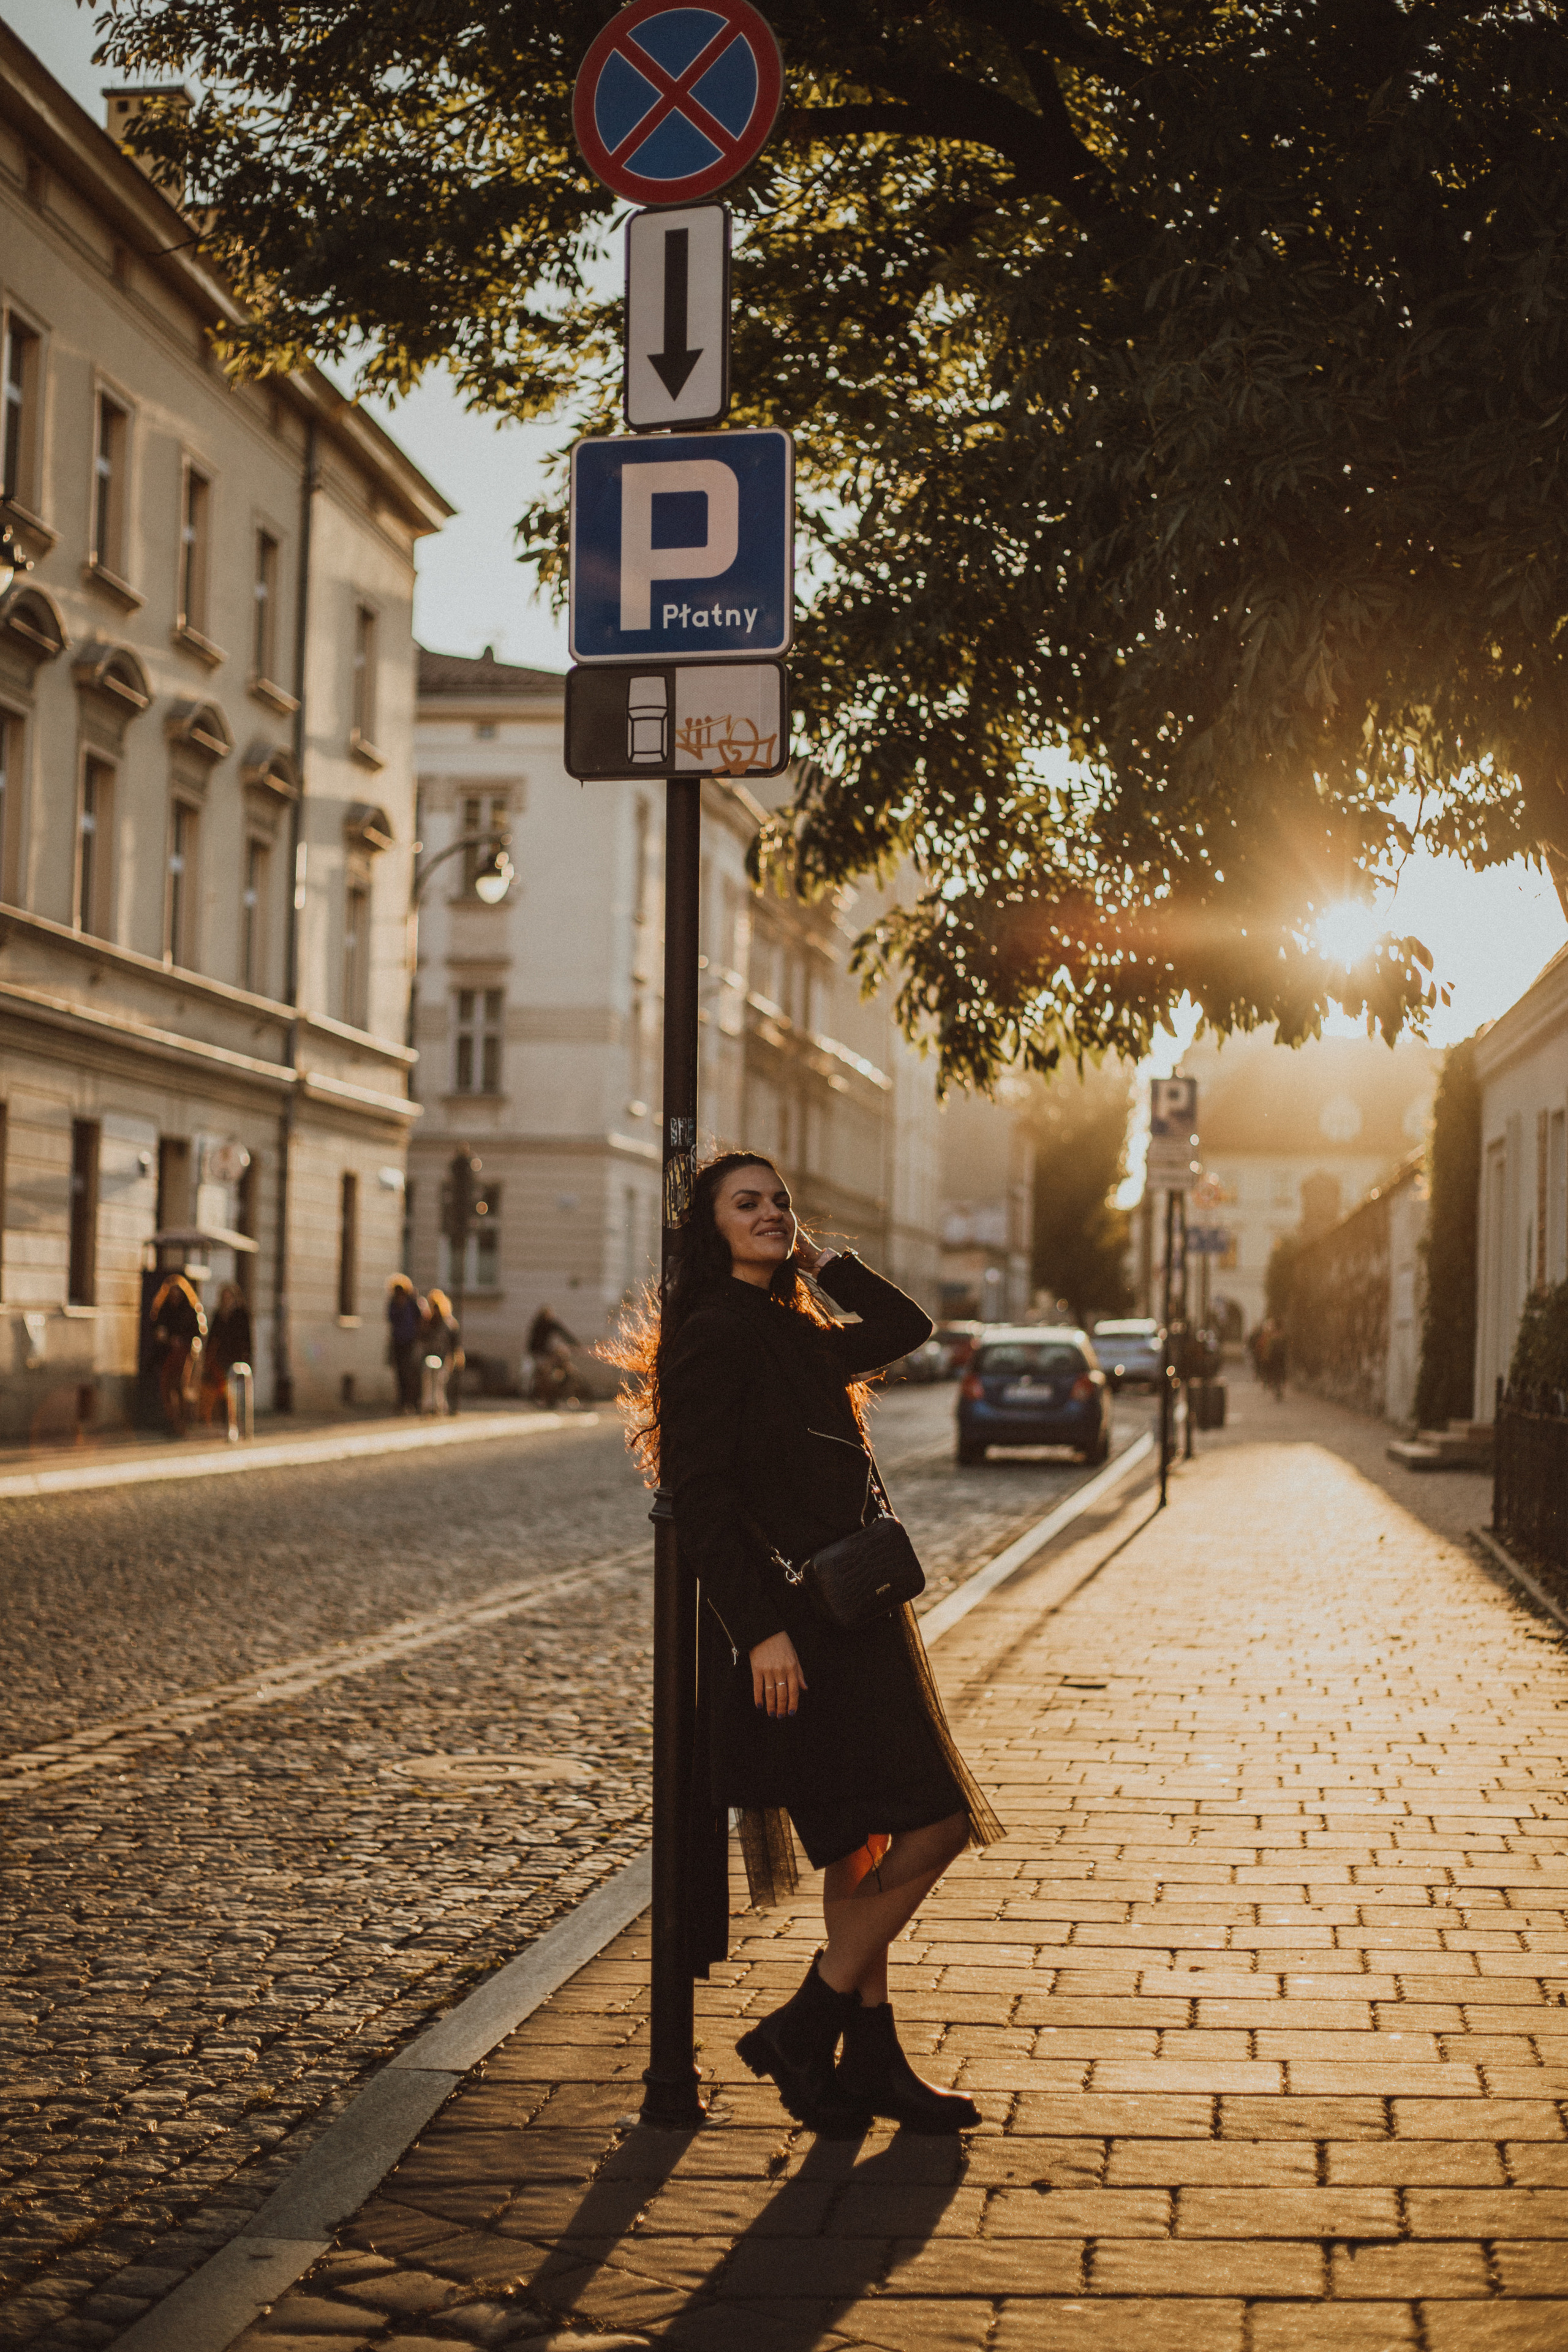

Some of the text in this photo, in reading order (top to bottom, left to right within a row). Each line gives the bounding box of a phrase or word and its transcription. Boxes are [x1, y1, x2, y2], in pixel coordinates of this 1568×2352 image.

[620, 459, 739, 631] P
[663, 603, 758, 633] Płatny
[1157, 1080, 1189, 1118] P
